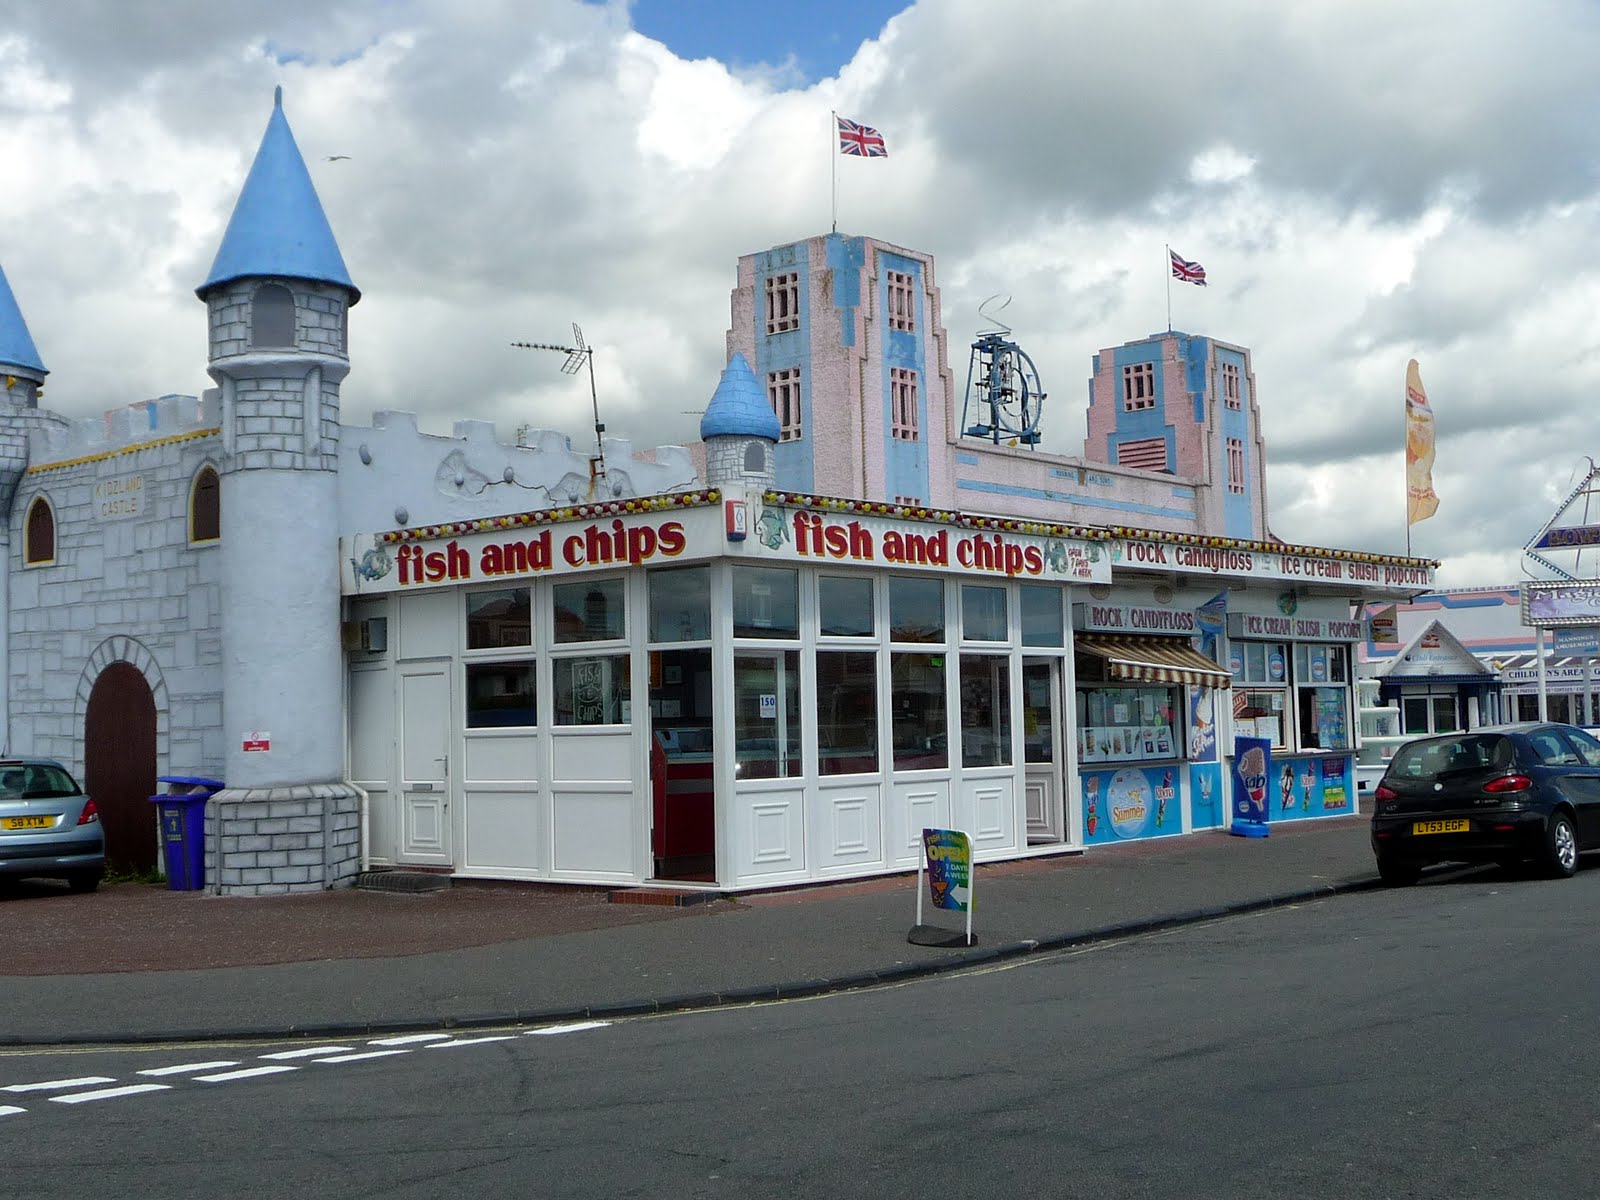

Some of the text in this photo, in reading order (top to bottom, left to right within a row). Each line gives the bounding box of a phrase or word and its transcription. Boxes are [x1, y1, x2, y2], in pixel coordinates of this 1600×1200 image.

[96, 475, 142, 496] KIDZLAND
[102, 497, 137, 516] CASTLE
[395, 519, 686, 586] fish and chips
[793, 510, 1045, 577] fish and chips
[1127, 541, 1428, 585] rock candyfloss ice cream slush popcorn
[1092, 606, 1194, 631] ROCK CANDYFLOSS
[1247, 615, 1362, 639] ICE CREAM SLUSH POPCORN
[1508, 669, 1559, 679] CHILDN'S
[761, 697, 775, 706] 150
[577, 702, 603, 721] CHIPS
[1245, 773, 1266, 789] fab
[1113, 806, 1146, 824] Summer
[1417, 819, 1465, 834] LT53 EGF
